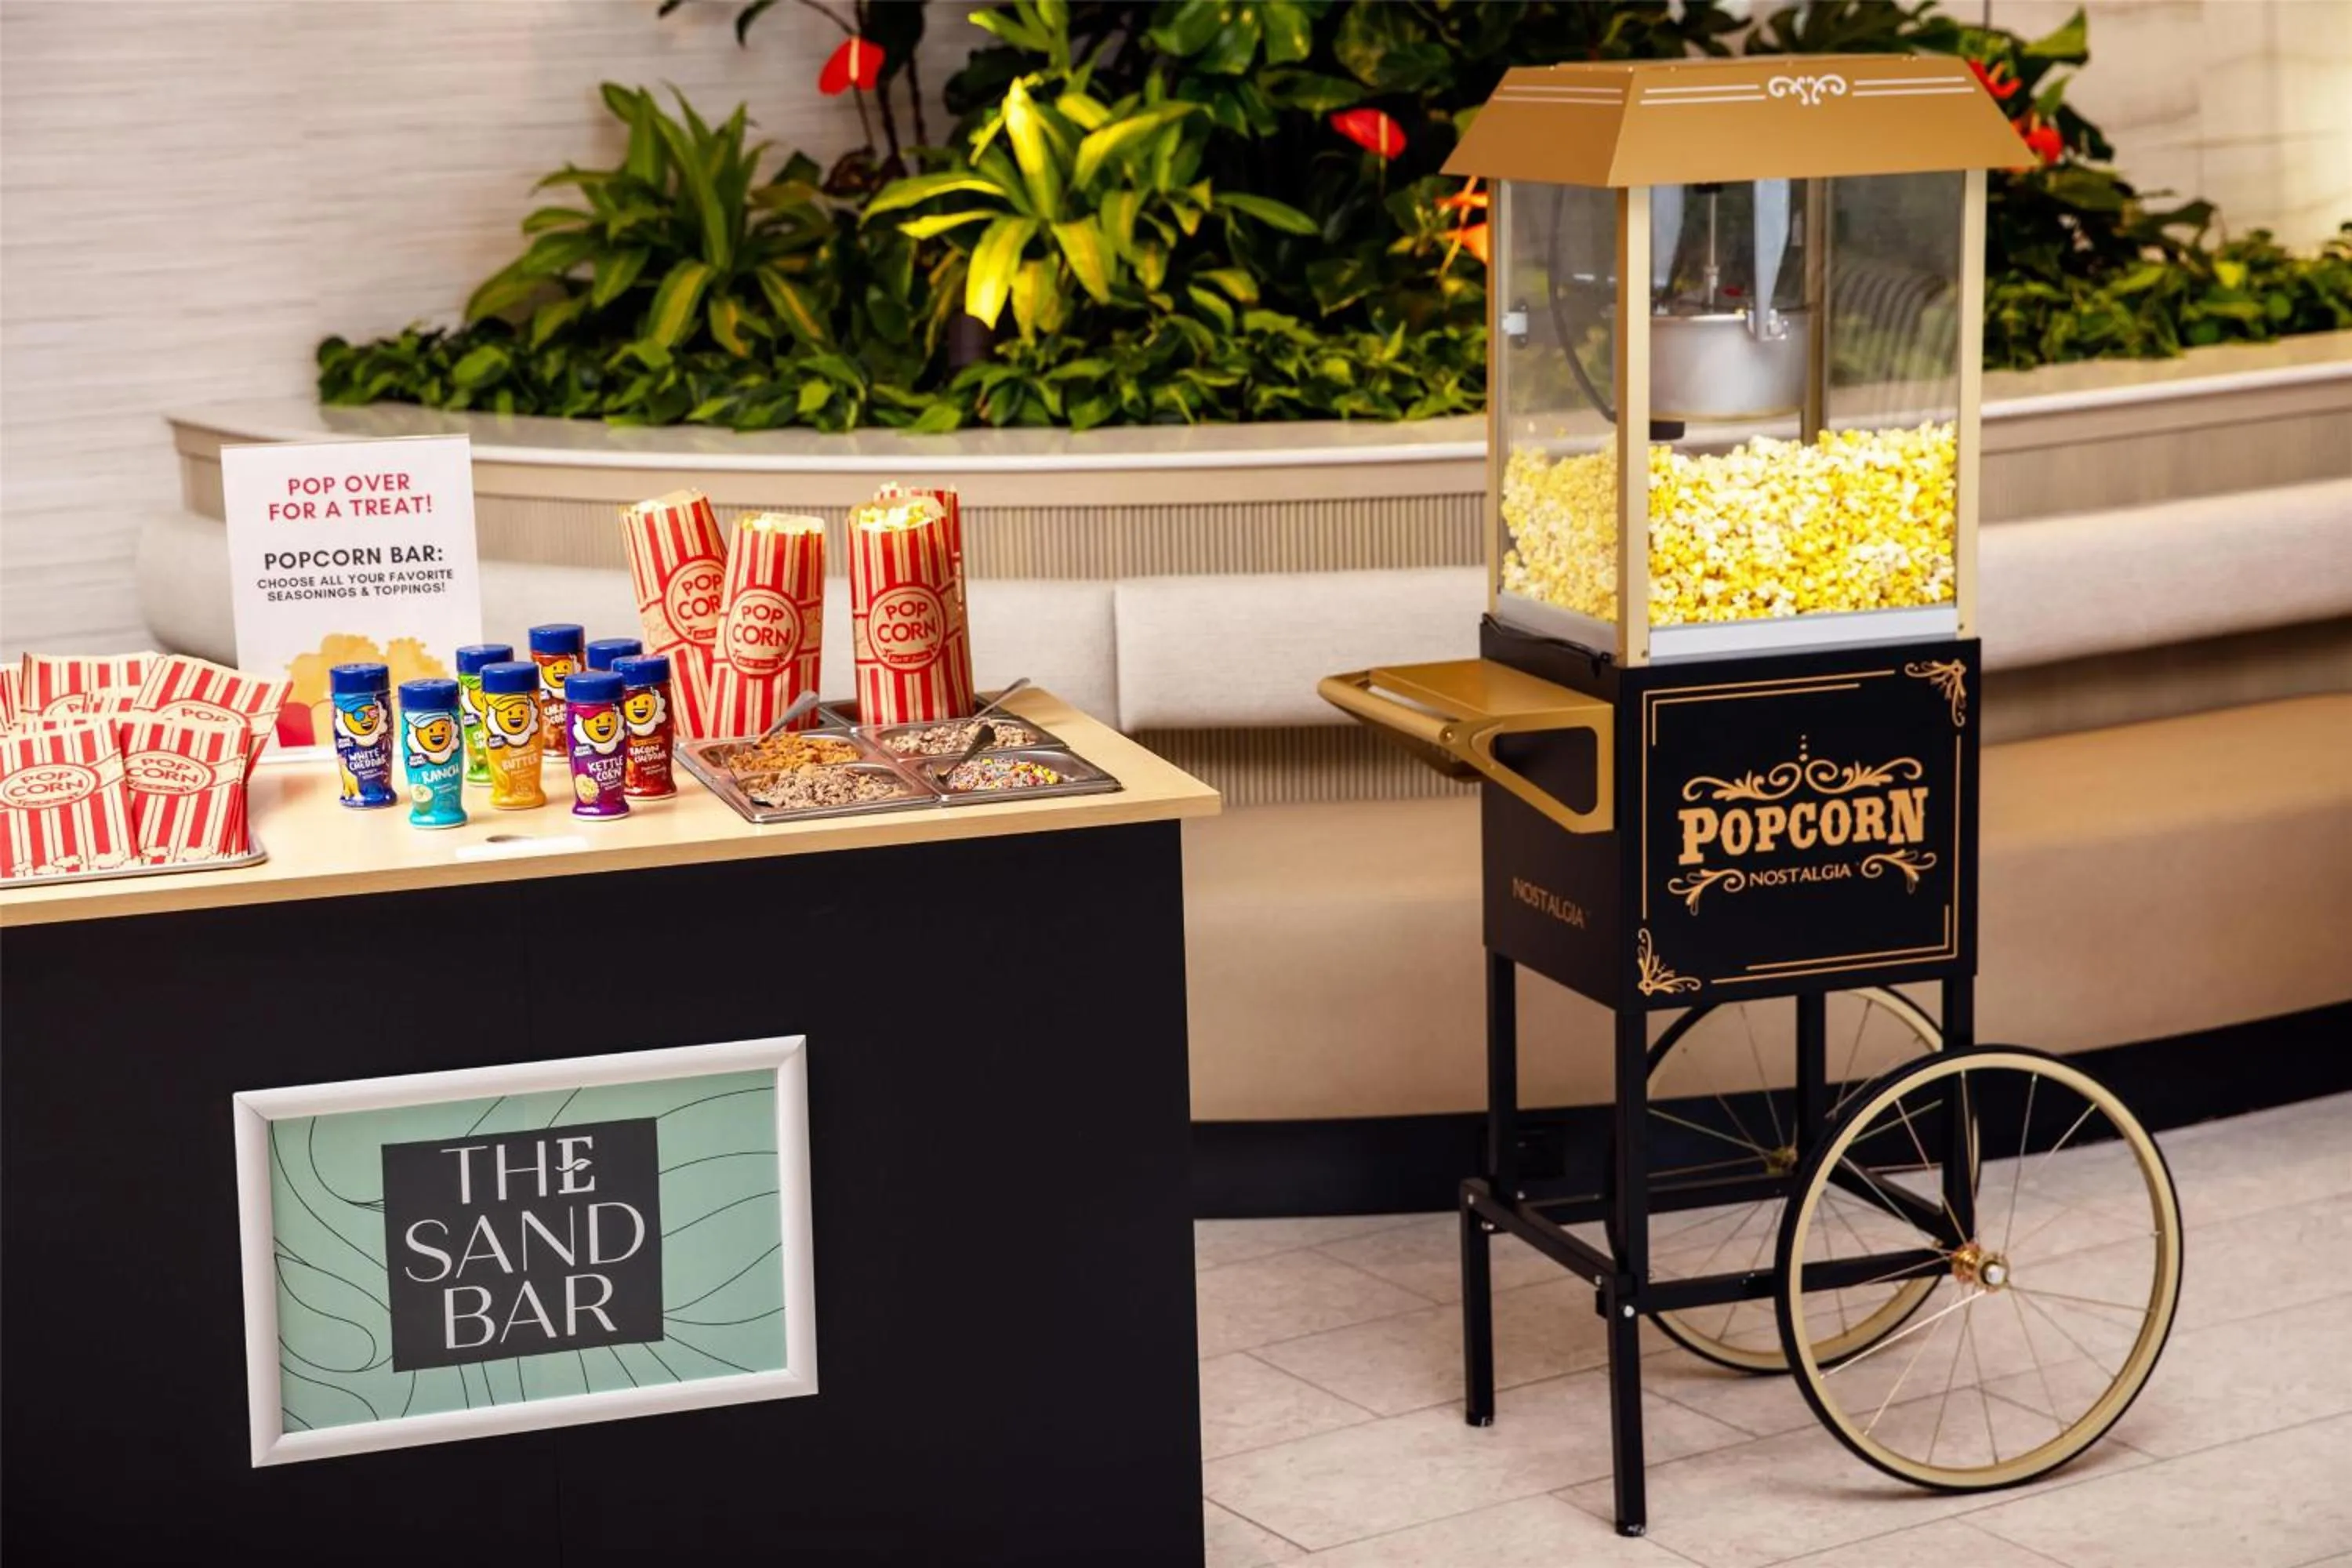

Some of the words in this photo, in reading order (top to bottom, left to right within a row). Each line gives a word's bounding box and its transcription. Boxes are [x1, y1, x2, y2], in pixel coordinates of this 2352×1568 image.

[288, 476, 336, 495] POP
[344, 473, 411, 493] OVER
[268, 501, 317, 521] FOR
[325, 500, 342, 517] A
[350, 494, 433, 517] TREAT!
[264, 546, 382, 571] POPCORN
[390, 544, 444, 564] BAR:
[256, 575, 315, 590] CHOOSE
[320, 574, 343, 586] ALL
[347, 572, 385, 585] YOUR
[390, 568, 454, 582] FAVORITE
[681, 573, 723, 597] POP
[267, 586, 358, 602] SEASONINGS
[361, 586, 370, 597] &
[374, 582, 446, 596] TOPPINGS!
[677, 594, 720, 621] COR
[741, 604, 785, 625] POP
[884, 600, 928, 621] POP
[731, 623, 791, 647] CORN
[877, 616, 937, 643] CORN
[181, 707, 229, 723] POP
[141, 757, 191, 771] POP
[347, 746, 380, 762] WHITE
[349, 753, 387, 771] CHEDDAR
[501, 753, 539, 771] BUTTER
[587, 754, 624, 774] KETTLE
[20, 771, 72, 784] POP
[125, 767, 198, 784] CORN
[597, 766, 622, 782] CORN
[9, 779, 84, 797] CORN
[1677, 786, 1929, 866] POPCORN
[1749, 865, 1853, 887] NOSTALGIA
[1512, 877, 1586, 930] NOSTALGIA
[440, 1134, 597, 1205] THE
[403, 1200, 646, 1283] SAND
[443, 1272, 618, 1351] BAR
